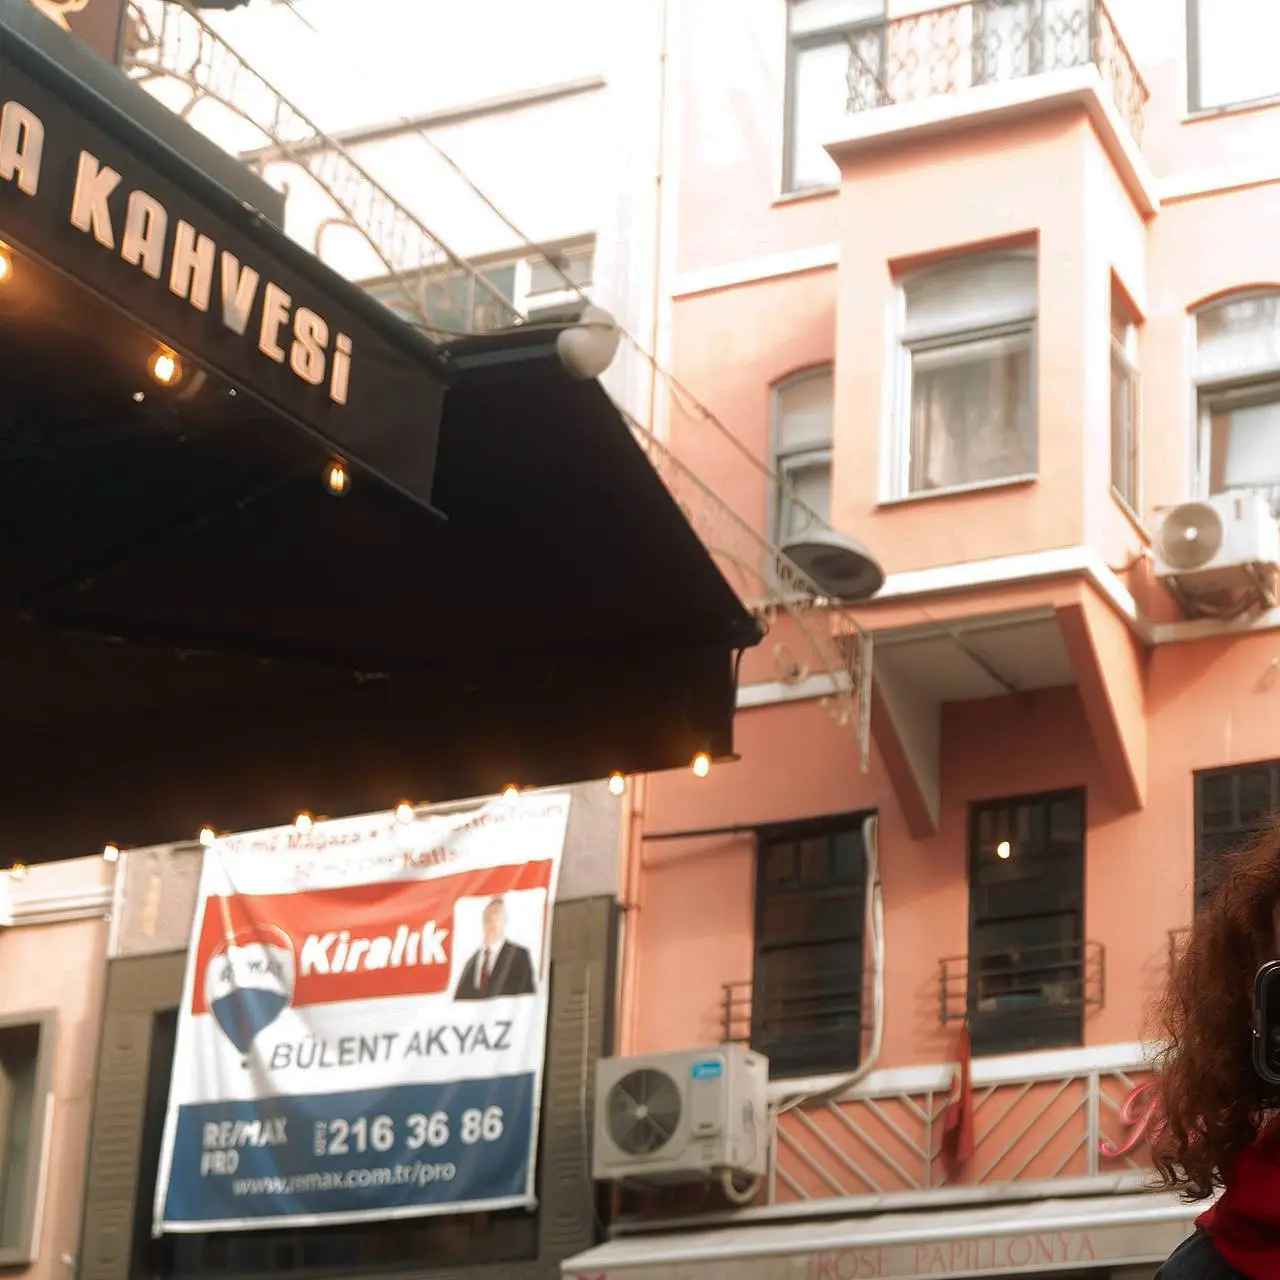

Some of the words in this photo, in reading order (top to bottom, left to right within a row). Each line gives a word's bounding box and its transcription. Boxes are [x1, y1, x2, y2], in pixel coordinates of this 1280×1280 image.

[300, 919, 450, 976] Kiralık
[404, 1020, 513, 1057] AKYAZ
[327, 1114, 395, 1155] 216
[406, 1110, 450, 1150] 36
[460, 1105, 504, 1145] 86
[913, 1230, 1096, 1276] PAPILLONYA
